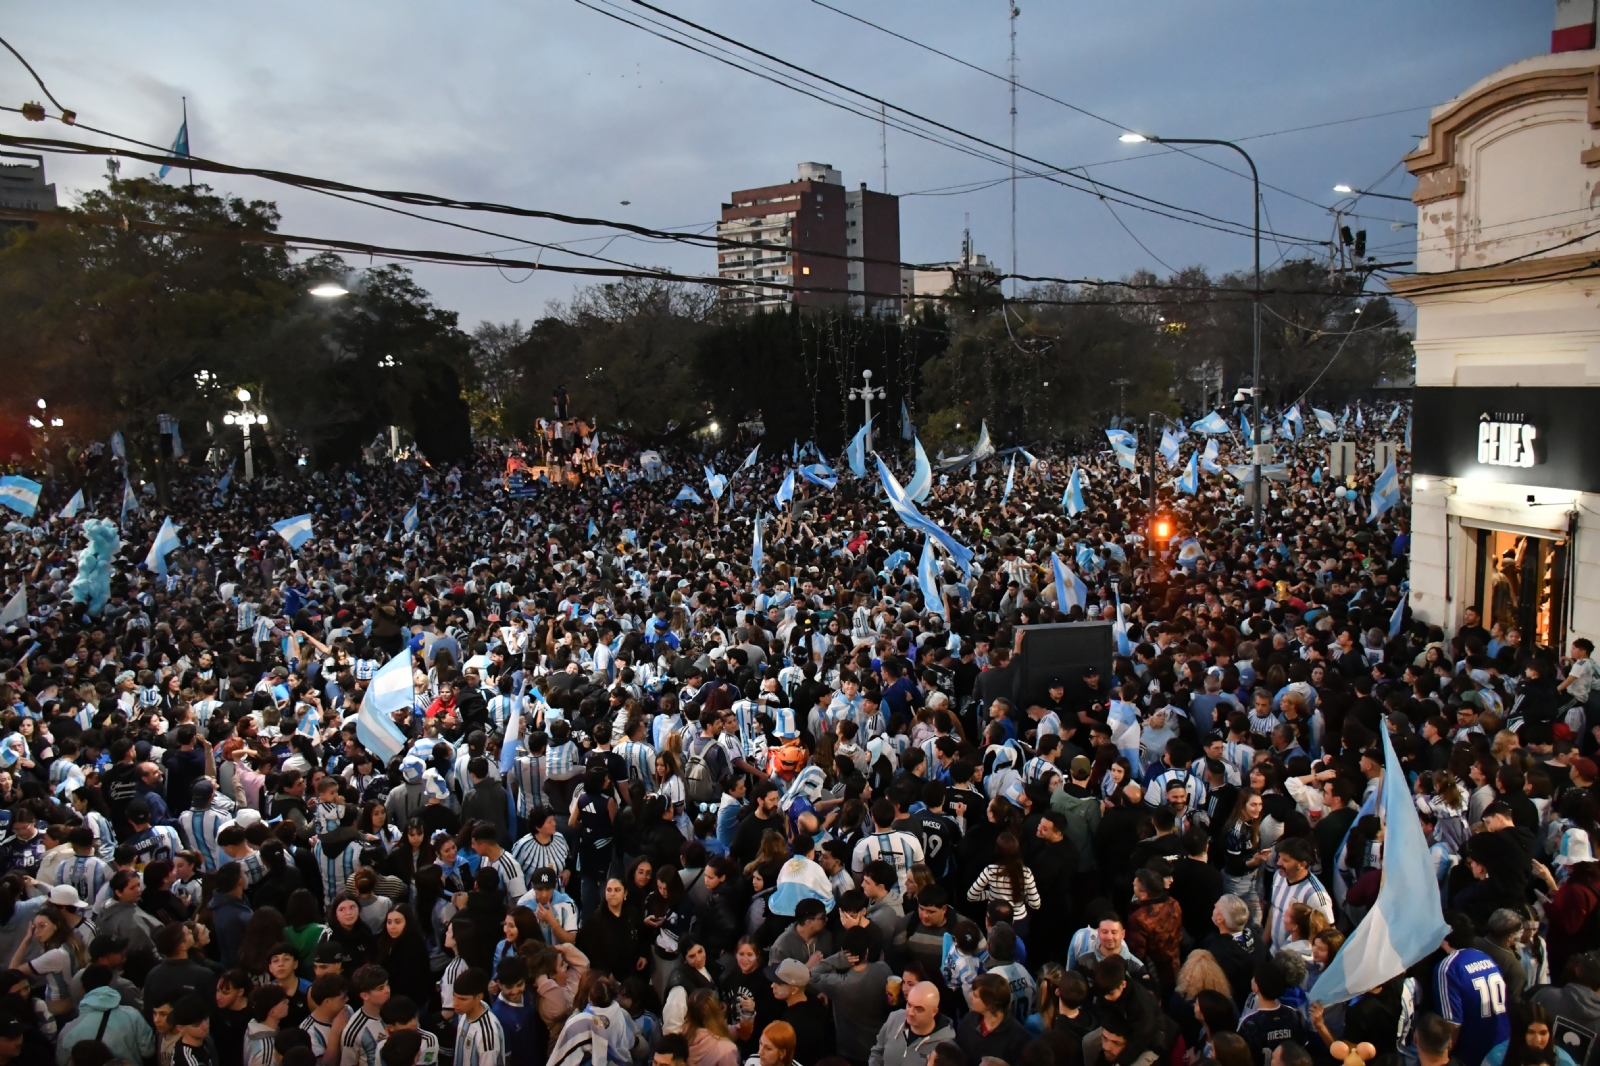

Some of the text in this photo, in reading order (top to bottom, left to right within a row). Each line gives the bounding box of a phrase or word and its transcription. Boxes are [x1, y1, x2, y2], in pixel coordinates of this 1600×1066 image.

[145, 690, 156, 701] 10
[922, 820, 942, 830] MESSI
[136, 834, 166, 851] UGADOR
[922, 832, 942, 868] 19
[24, 856, 34, 867] 10
[1471, 972, 1506, 1019] 10
[1267, 1029, 1292, 1040] MESSI
